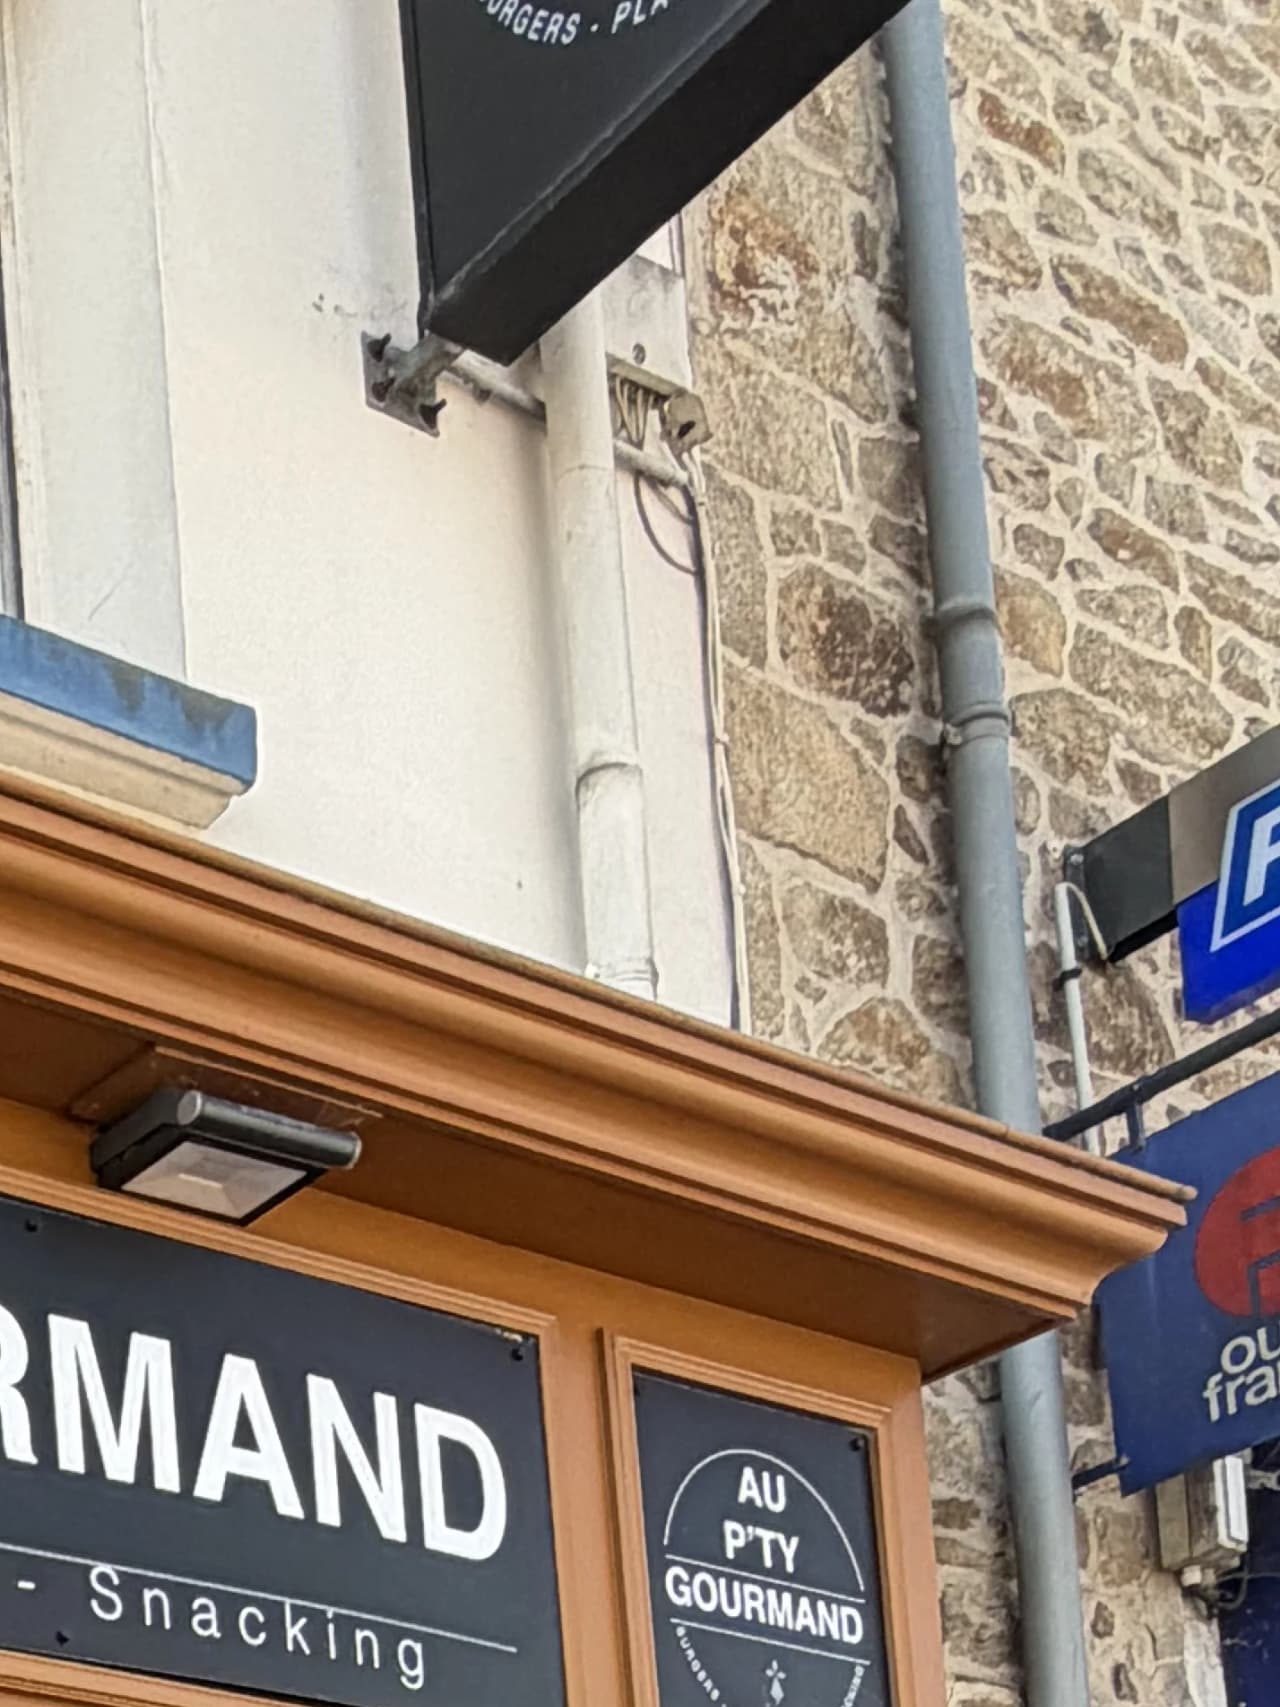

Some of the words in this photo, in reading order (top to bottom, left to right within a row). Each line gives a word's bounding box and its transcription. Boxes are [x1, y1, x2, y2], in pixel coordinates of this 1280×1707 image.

[480, 0, 580, 45] URGERS
[1203, 1361, 1280, 1422] fra
[738, 1466, 787, 1512] AU
[723, 1520, 799, 1573] P'TY
[90, 1565, 430, 1691] Snacking
[665, 1566, 863, 1644] GOURMAND
